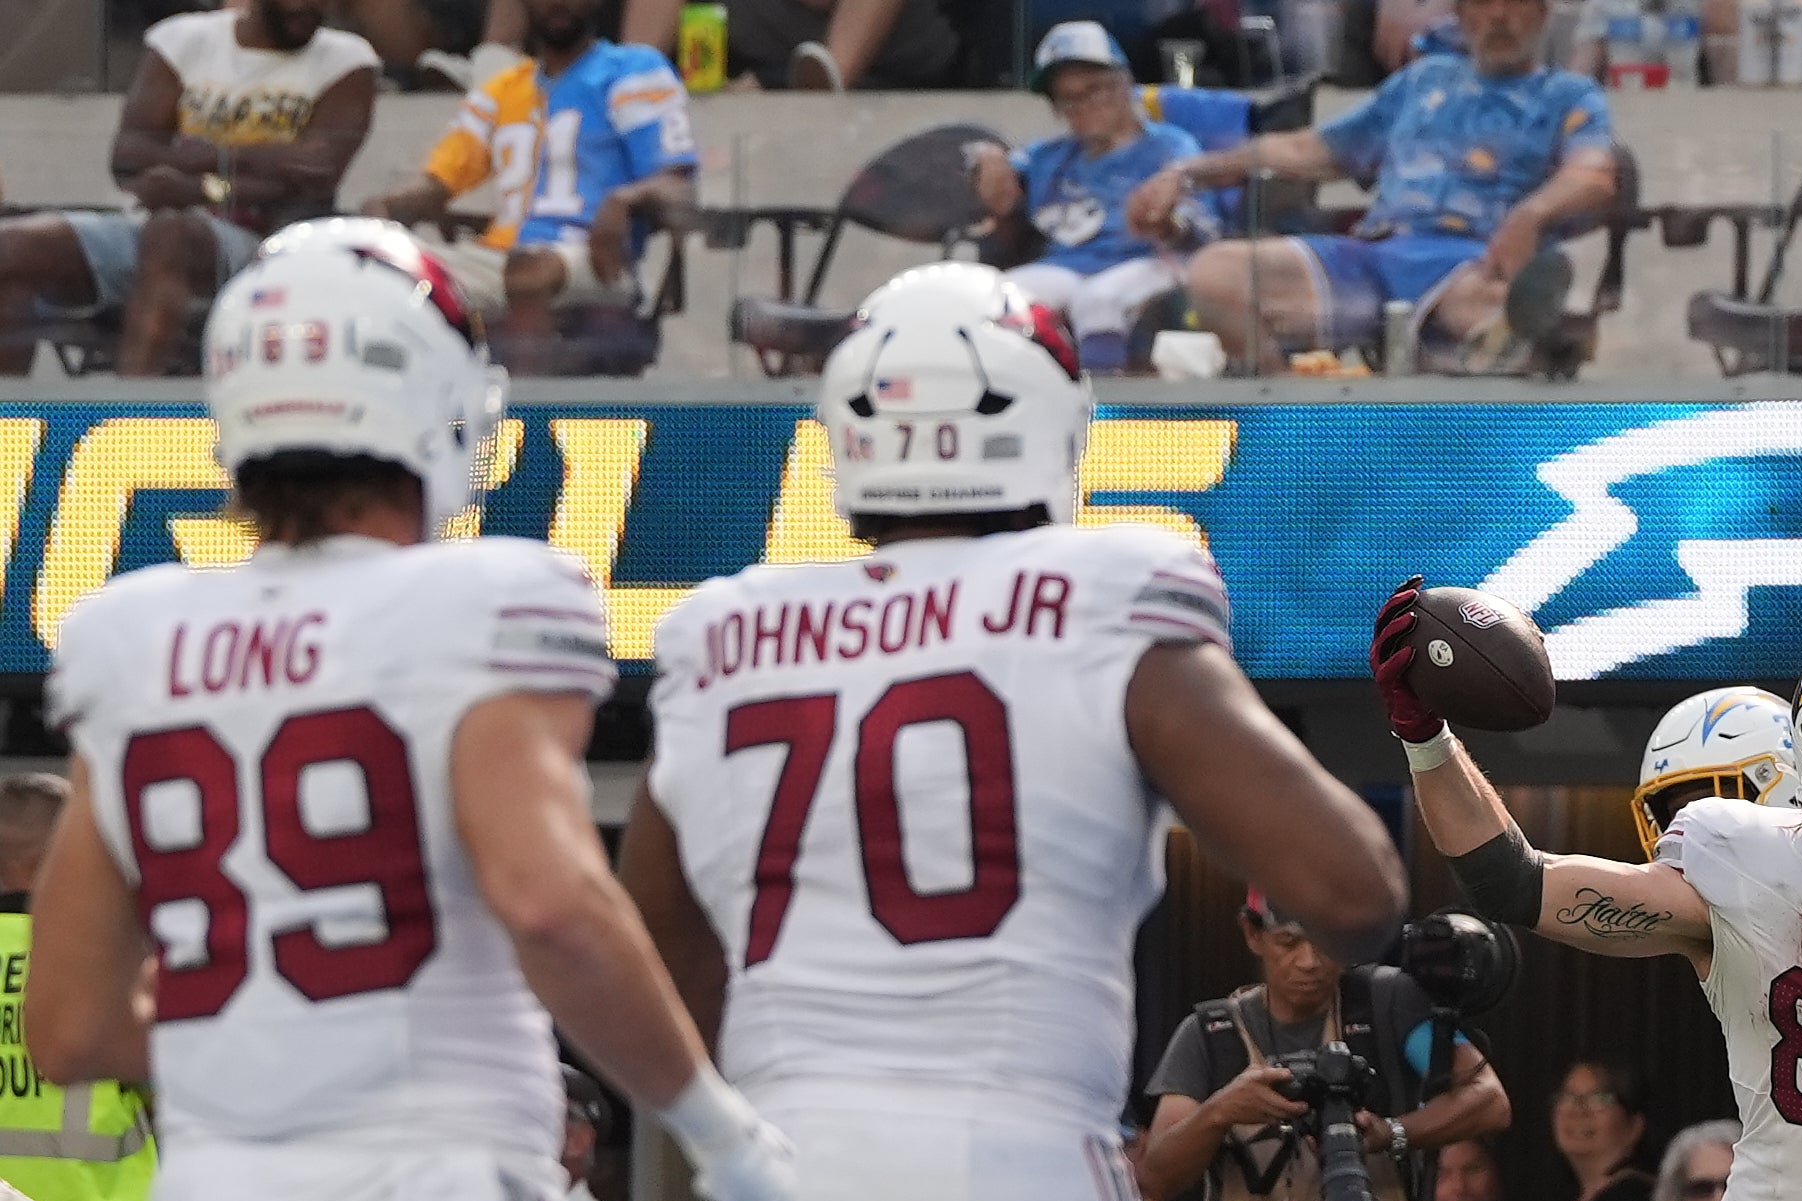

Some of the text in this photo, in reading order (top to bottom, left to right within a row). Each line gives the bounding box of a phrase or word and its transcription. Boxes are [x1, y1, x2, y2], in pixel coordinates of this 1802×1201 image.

[896, 423, 959, 461] 70
[169, 612, 328, 699] LONG
[696, 572, 1074, 690] JOHNSON JR
[1464, 601, 1497, 626] NFL
[122, 703, 438, 1024] 89
[724, 669, 1021, 970] 70
